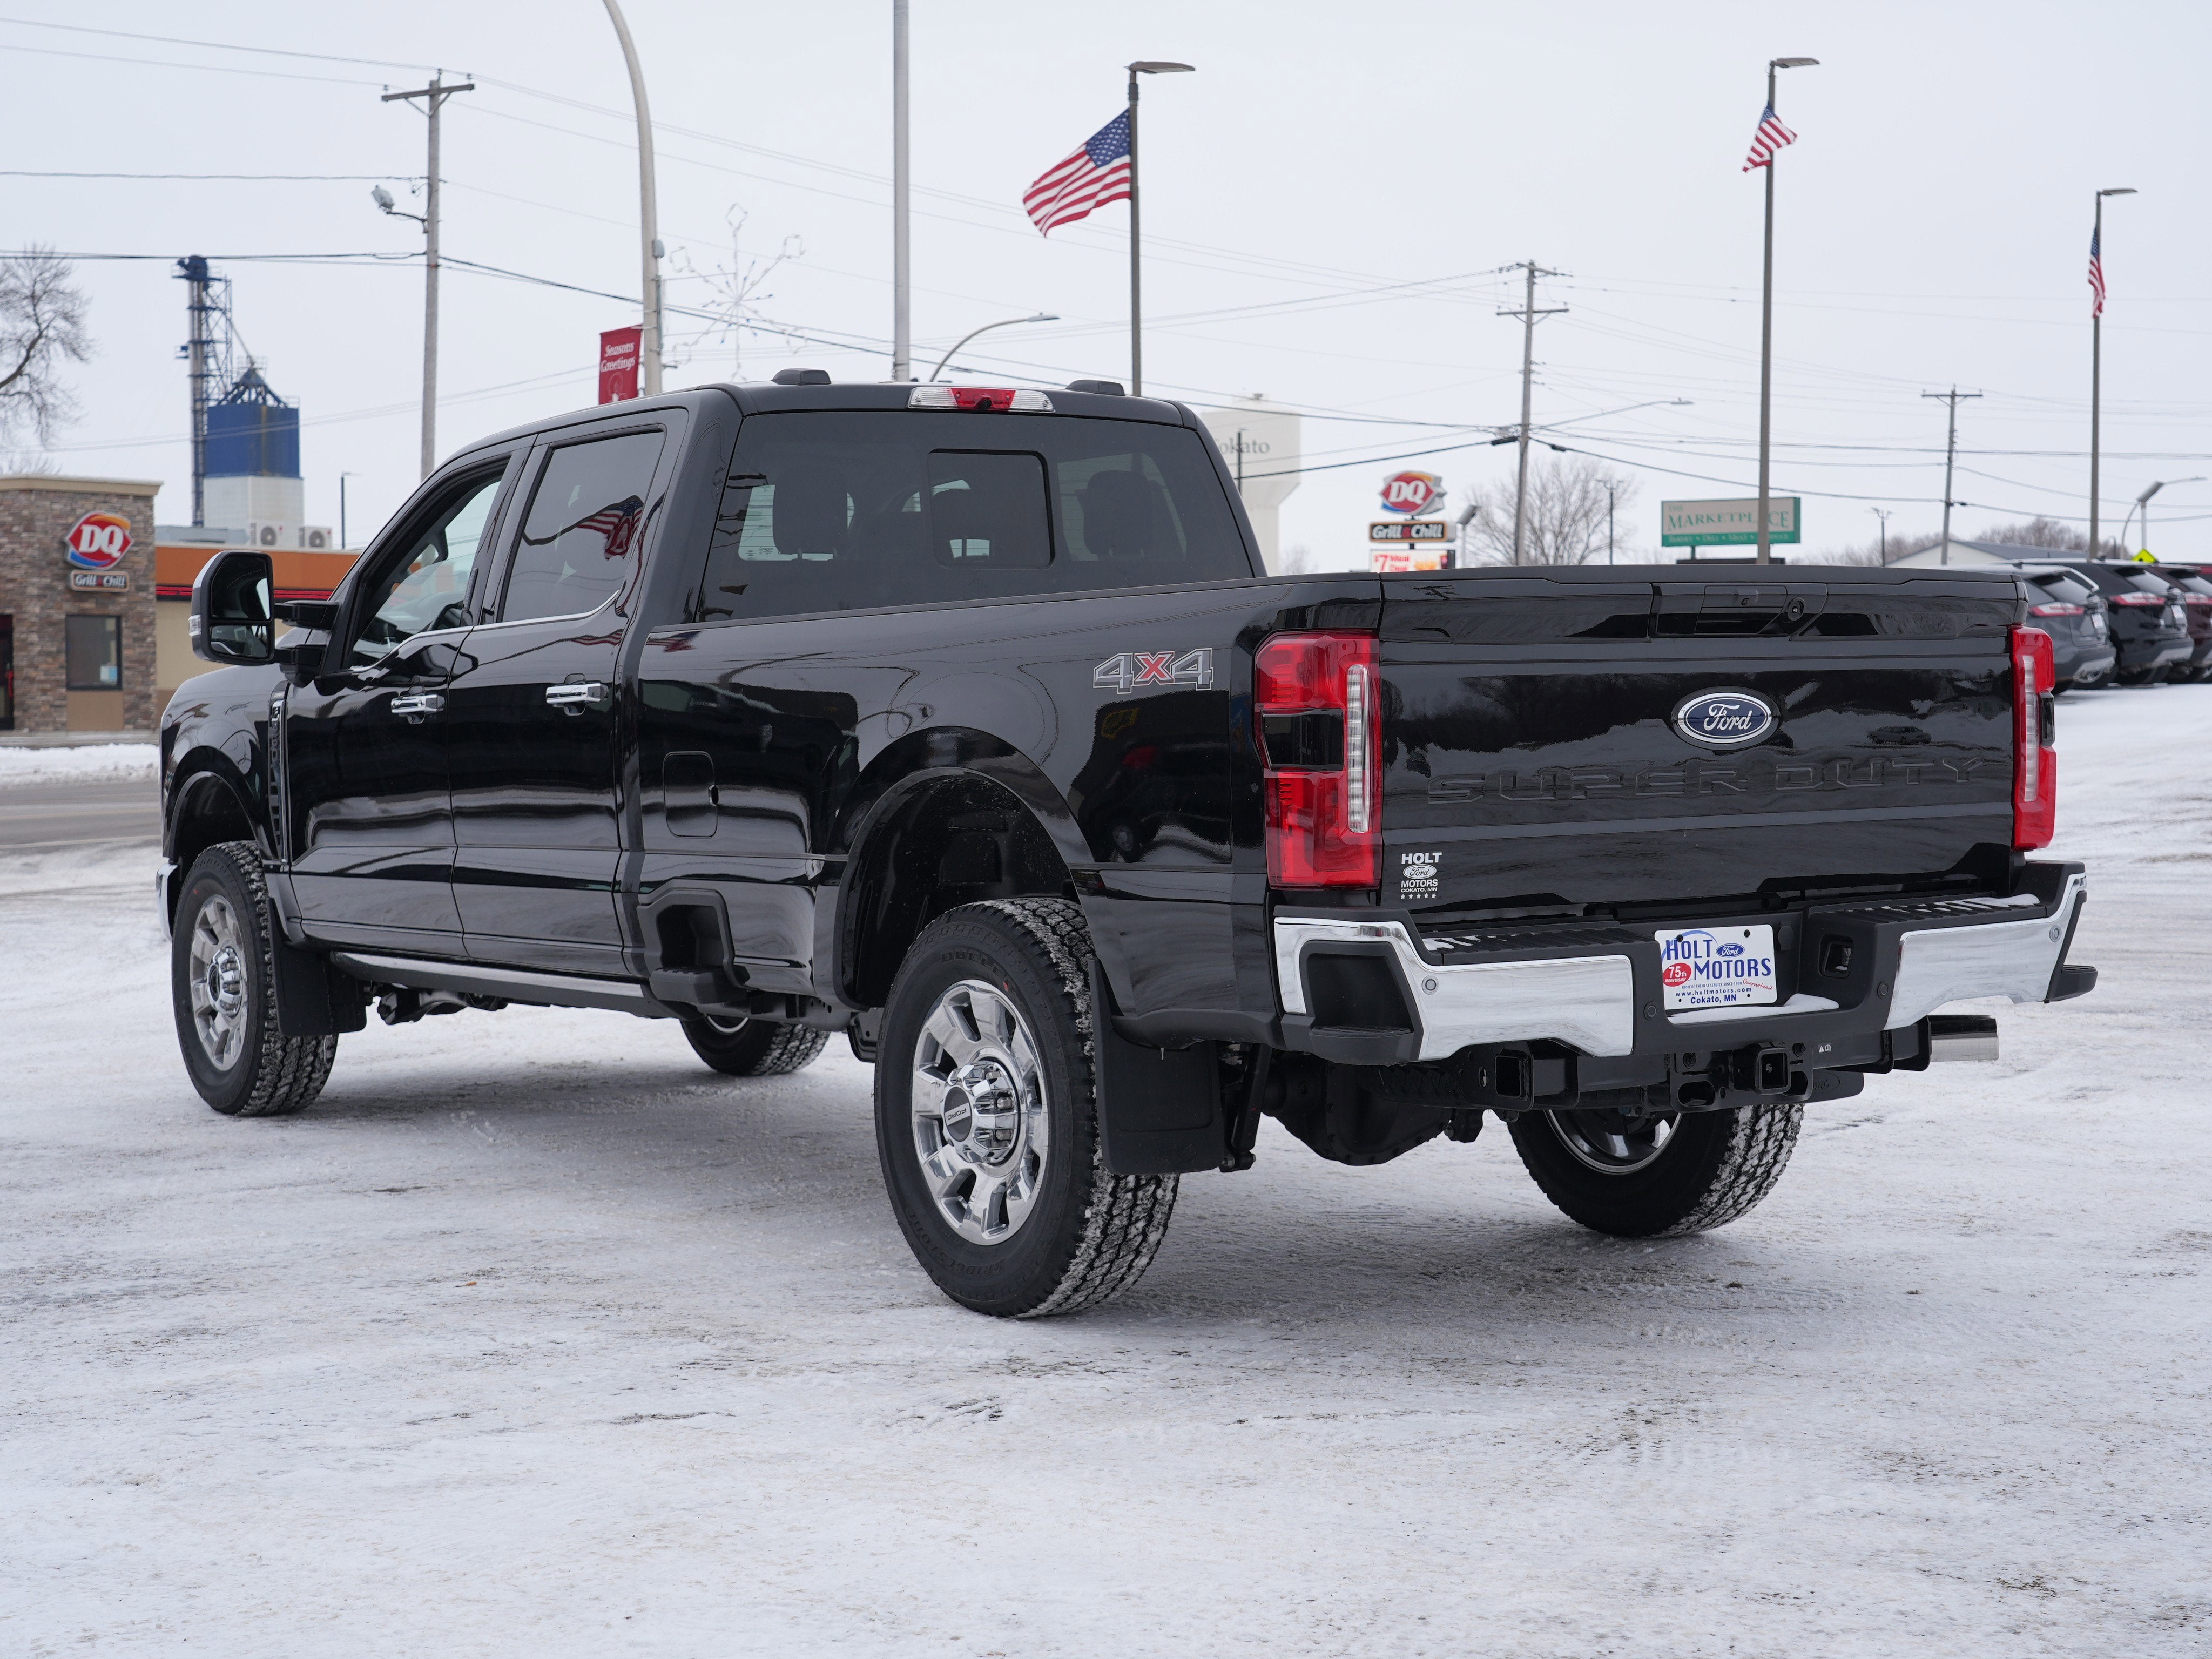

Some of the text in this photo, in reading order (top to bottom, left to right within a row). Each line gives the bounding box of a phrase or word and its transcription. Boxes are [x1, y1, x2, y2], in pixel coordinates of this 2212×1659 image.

[604, 342, 635, 357] Seasons
[601, 356, 636, 372] Greetings
[1217, 436, 1271, 454] okato
[1388, 480, 1426, 505] DQ
[1667, 511, 1789, 531] MARKETPLCE
[1372, 523, 1443, 539] Grill Chill
[78, 524, 123, 558] DQ
[75, 574, 125, 588] Grill Chill
[1703, 703, 1753, 731] Ford
[1427, 756, 1985, 804] SUPER DUTY
[1401, 852, 1442, 864] HOLT
[1410, 866, 1430, 876] Ford
[1401, 879, 1438, 888] MOTORS
[1665, 939, 1739, 960] HOLT Ford
[1668, 958, 1771, 980] 75th MOTORS
[1676, 988, 1752, 997] www.holtmotors.com
[1743, 978, 1773, 991] Guaranteed
[1690, 994, 1737, 1004] Cokato, MN
[947, 1108, 967, 1120] FORD
